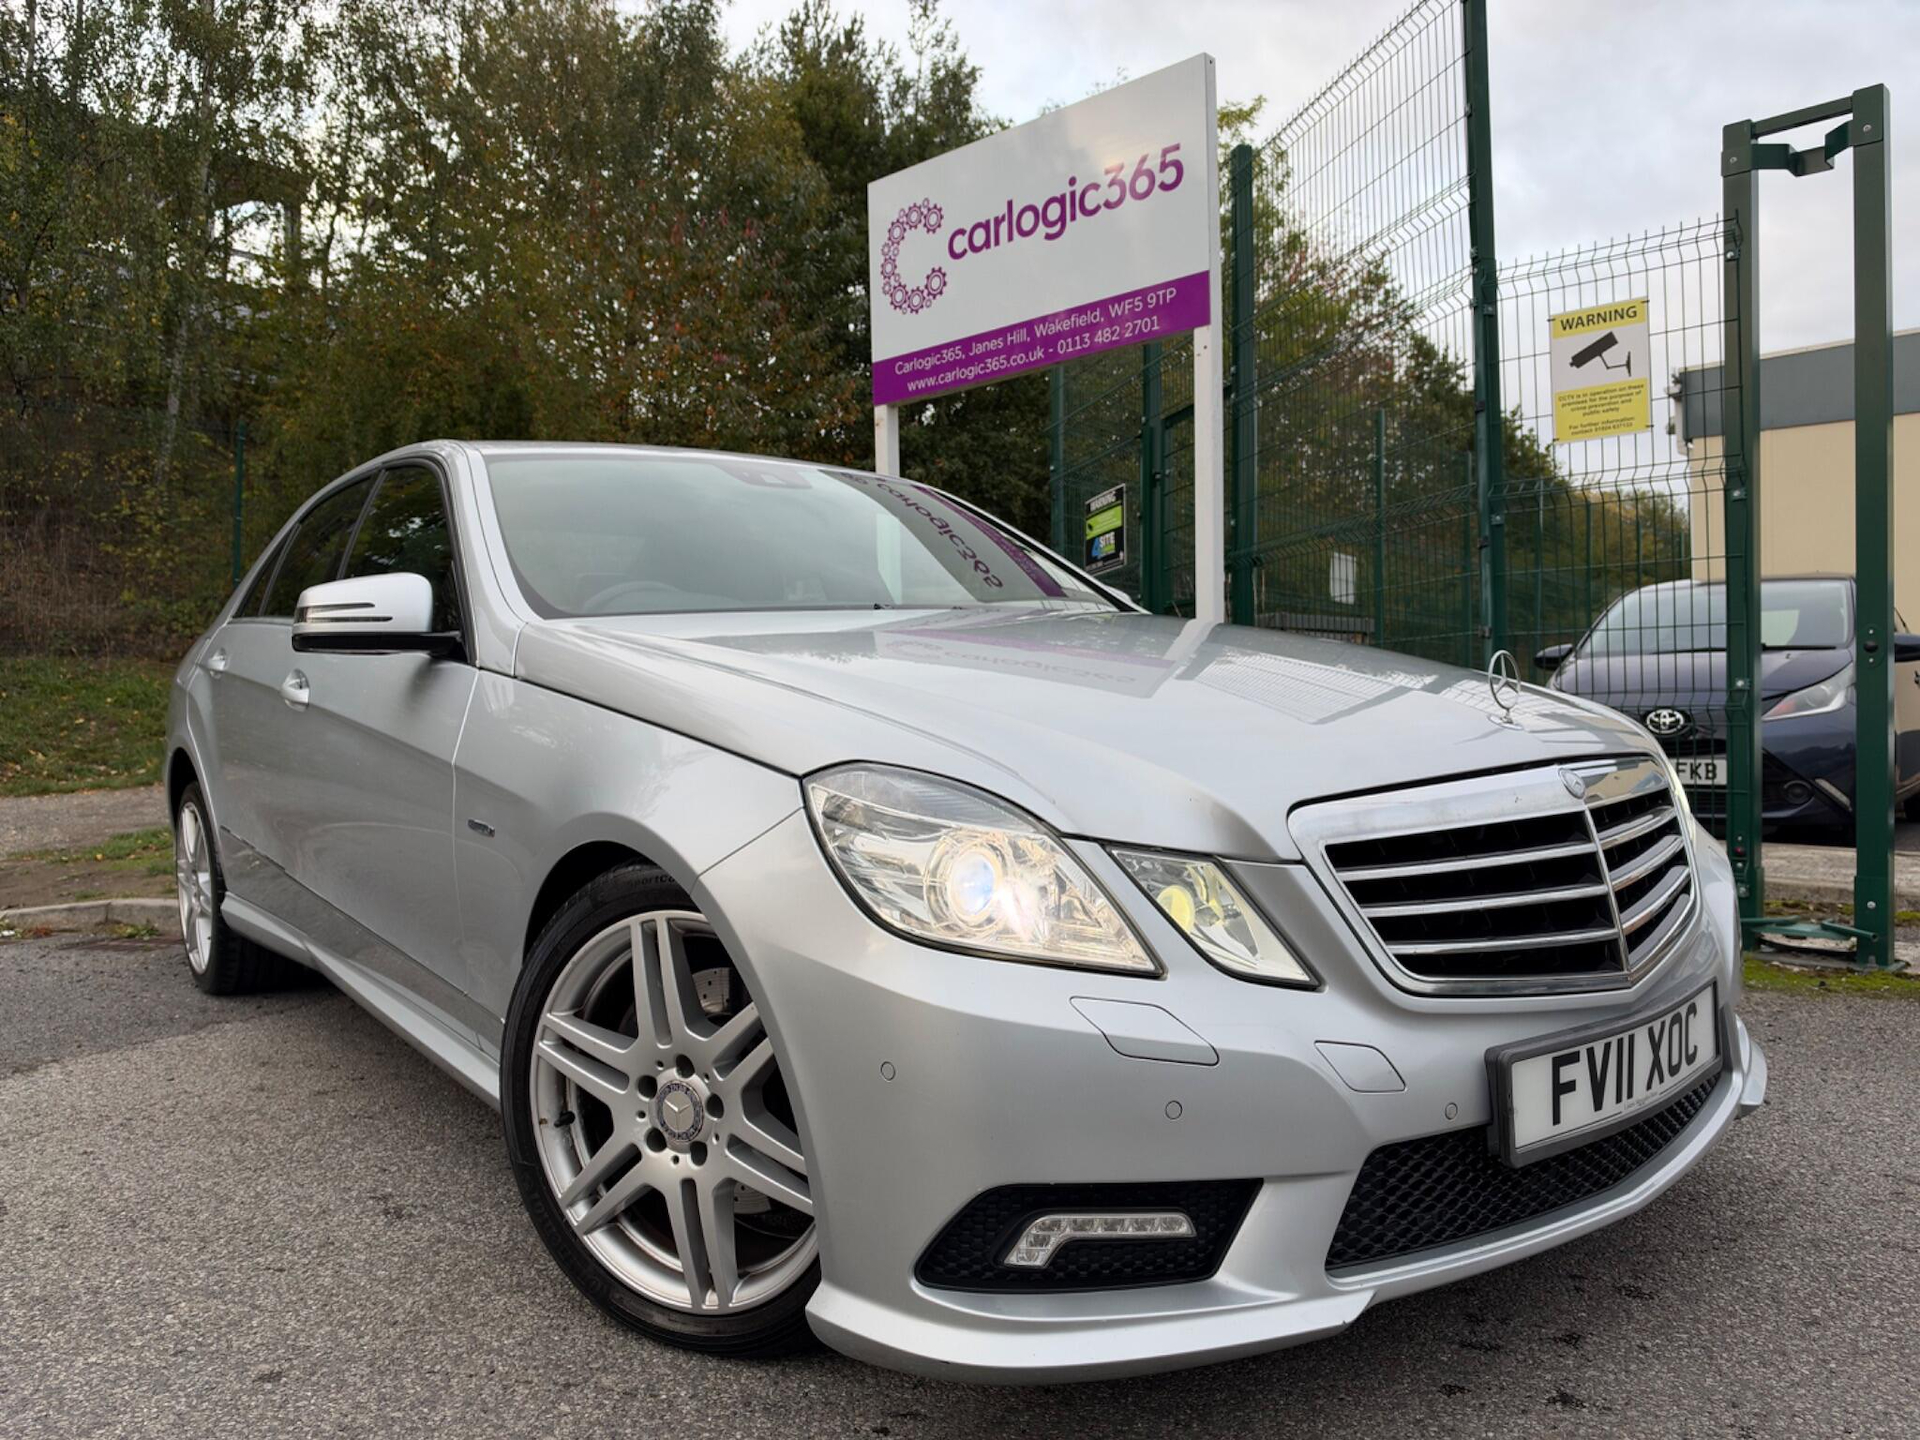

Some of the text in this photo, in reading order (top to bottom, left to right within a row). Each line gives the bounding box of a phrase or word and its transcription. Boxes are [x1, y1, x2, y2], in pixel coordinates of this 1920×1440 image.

[947, 143, 1184, 260] carlogic365
[895, 287, 1177, 375] Carlogic365, Janes Hill, Wakefield, WF5 9TP
[907, 346, 1044, 391] www.carlogic365.co.uk
[1057, 333, 1091, 354] 0113
[1094, 325, 1119, 344] 482
[1124, 315, 1160, 338] 2701
[1561, 305, 1637, 331] WARNING
[1552, 1002, 1698, 1127] FV11 XOC
